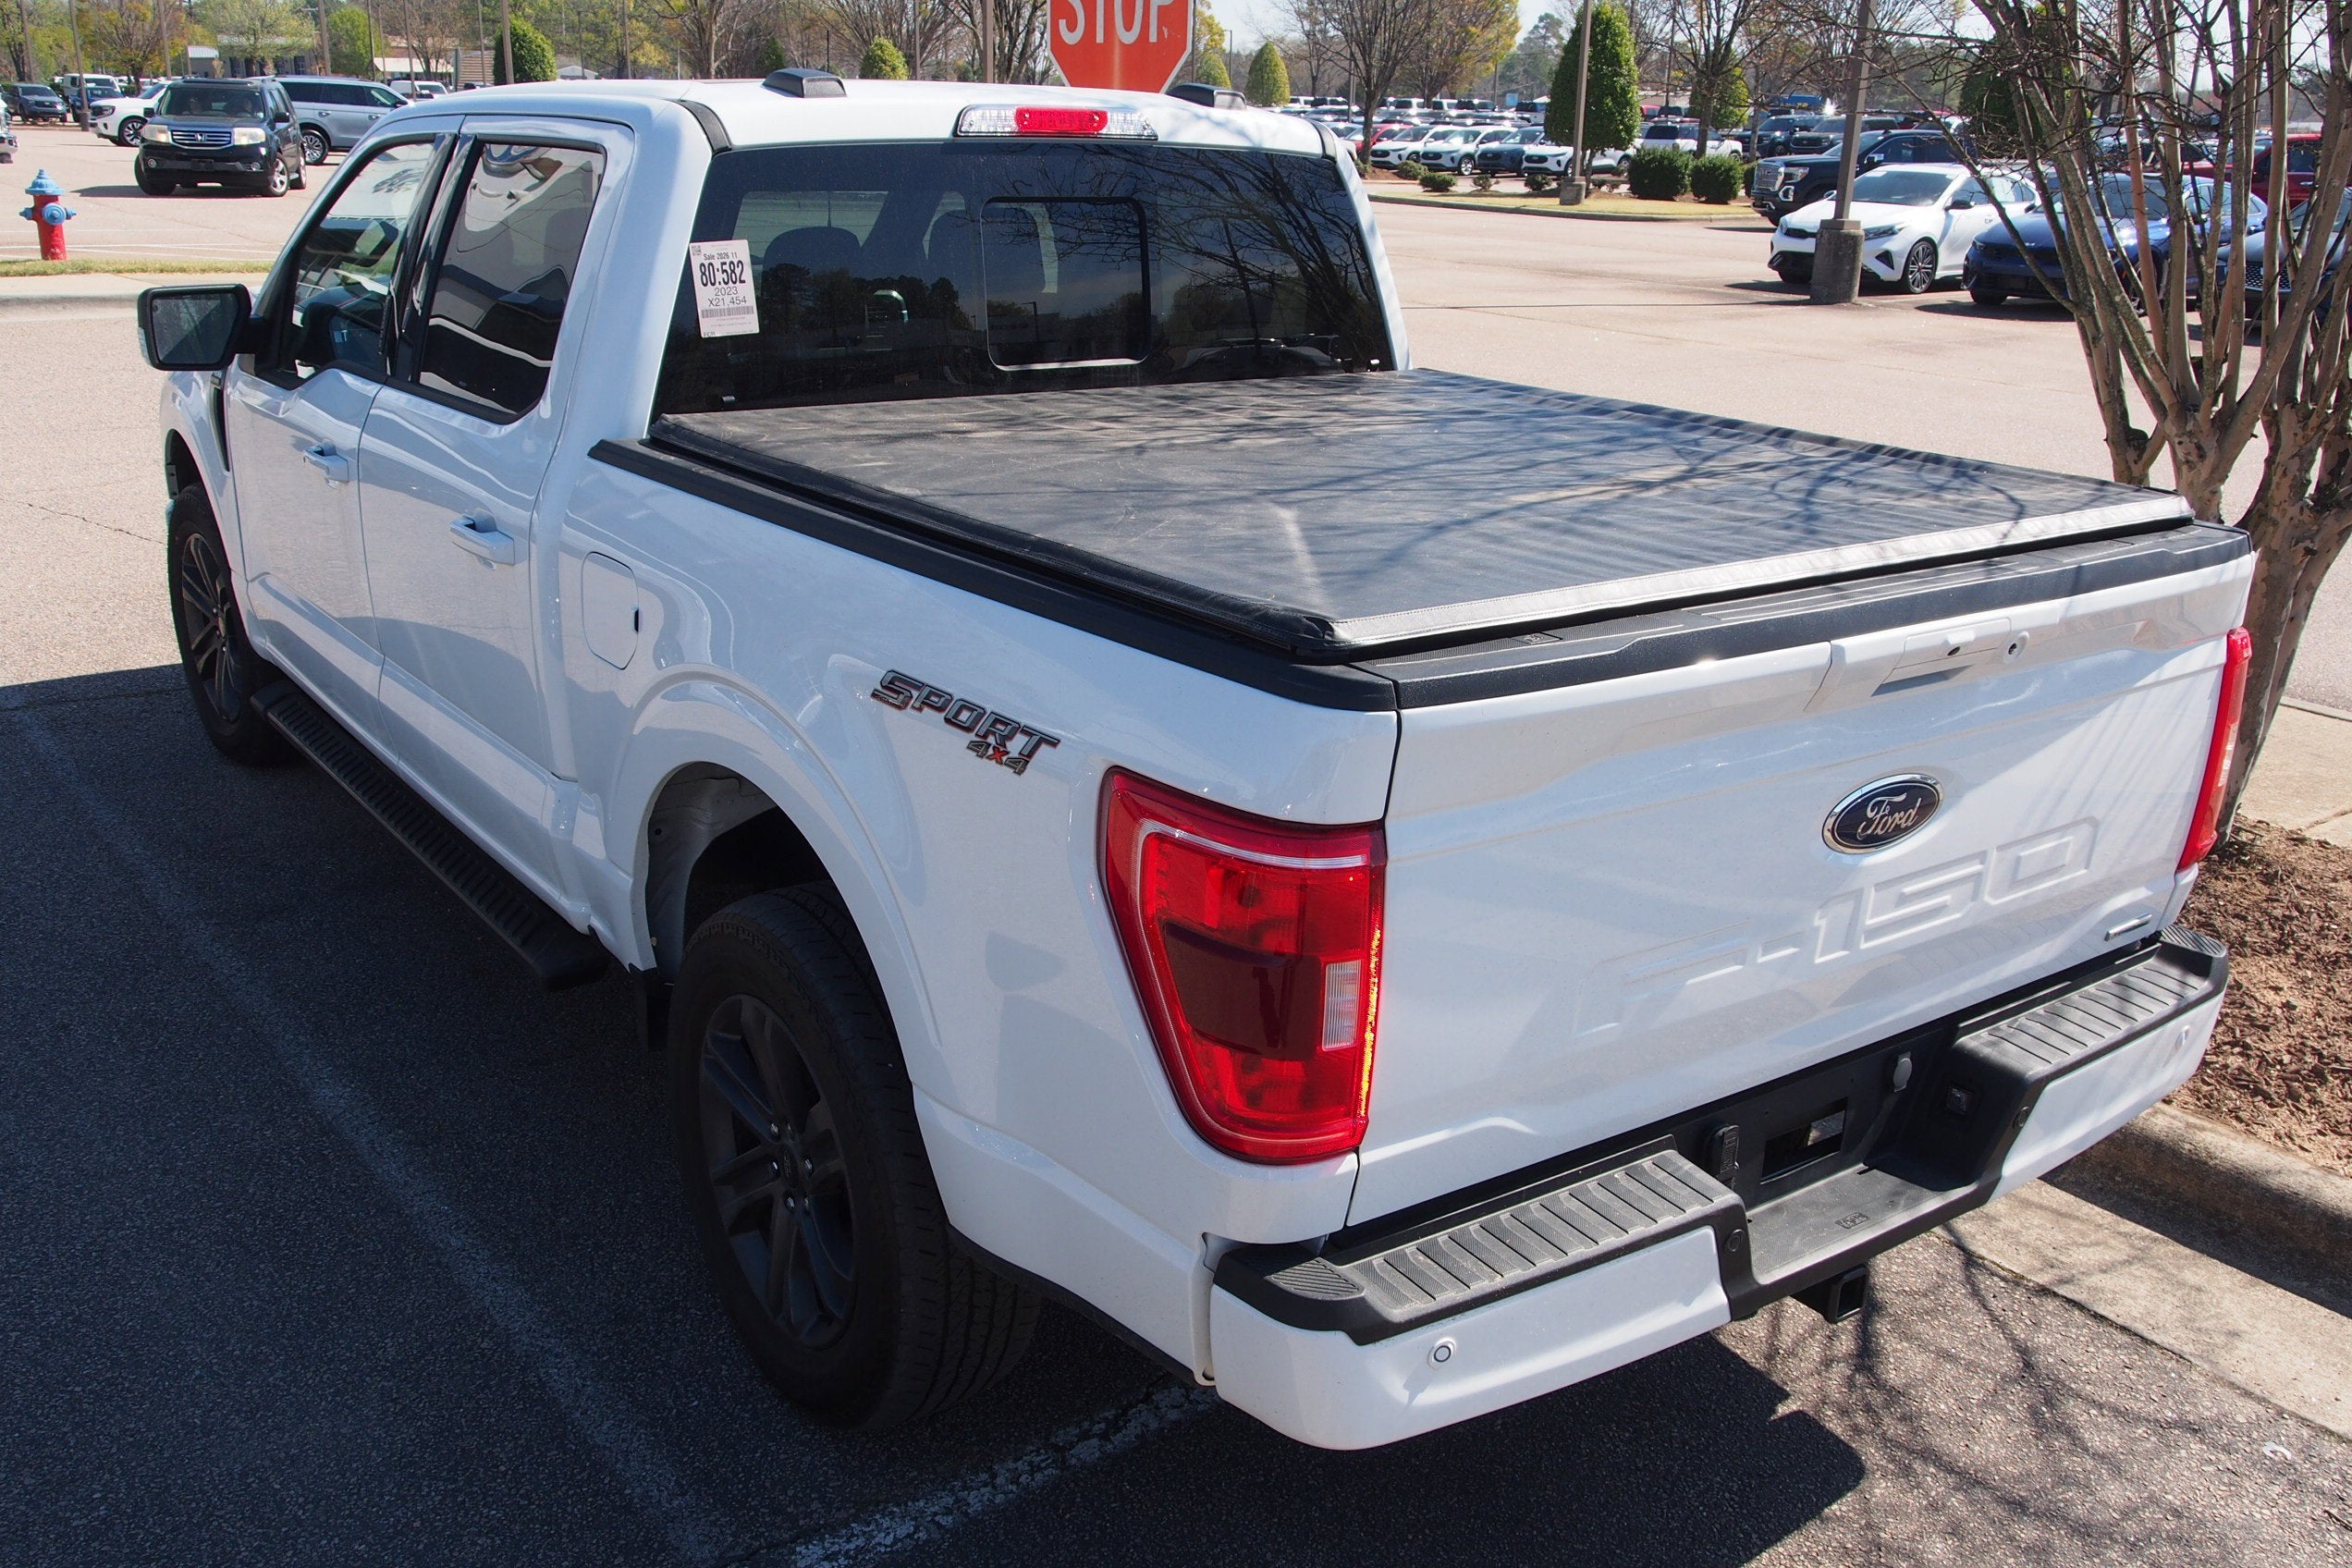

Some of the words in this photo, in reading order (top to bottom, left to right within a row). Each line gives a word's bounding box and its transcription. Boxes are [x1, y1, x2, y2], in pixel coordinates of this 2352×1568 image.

[699, 260, 745, 287] 80:582
[715, 287, 739, 296] 2023
[708, 296, 747, 307] X21,454
[872, 669, 1061, 759] SPORT
[1856, 792, 1922, 839] Ford
[1574, 815, 2101, 1037] F-150
